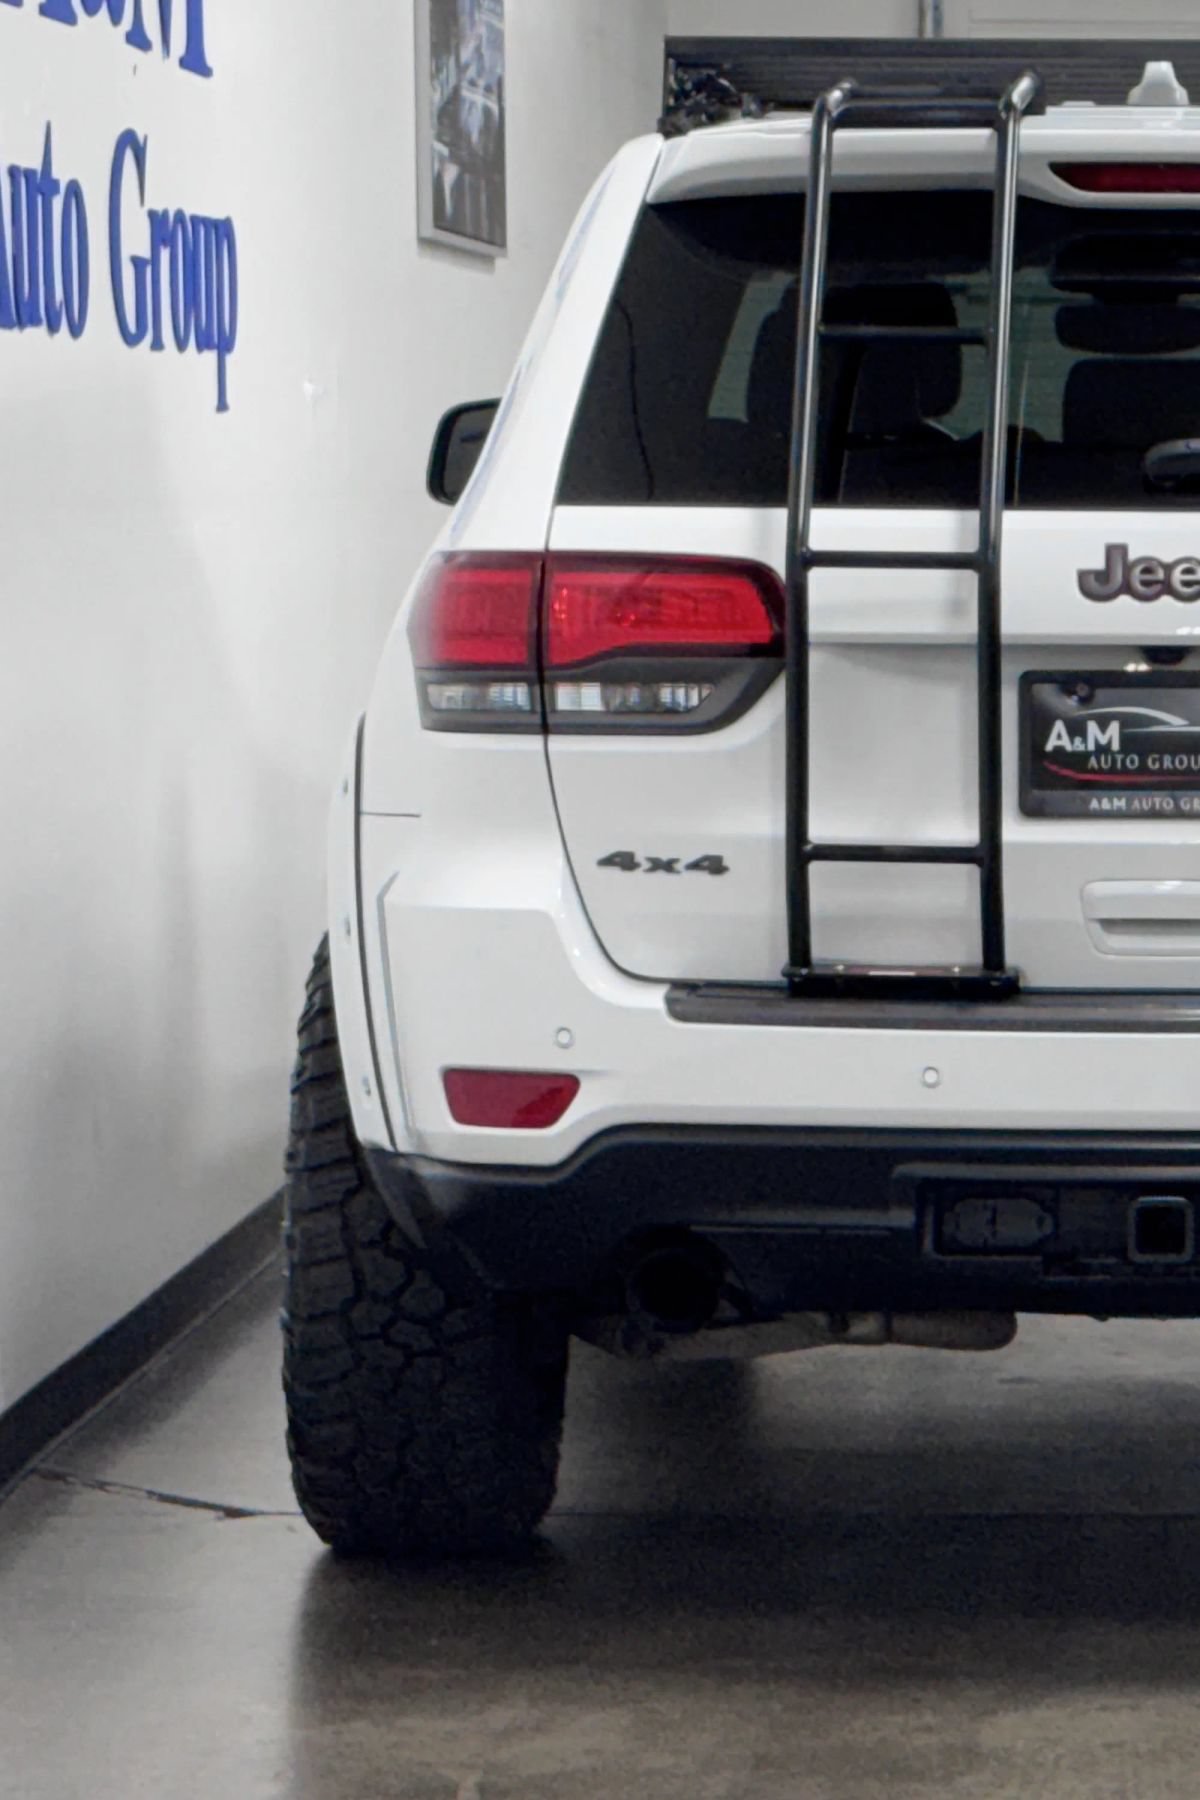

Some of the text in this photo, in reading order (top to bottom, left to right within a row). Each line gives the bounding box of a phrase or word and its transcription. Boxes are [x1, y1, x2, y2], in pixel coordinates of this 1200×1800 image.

[109, 128, 238, 412] Group
[1045, 719, 1121, 752] A&M
[1088, 754, 1139, 770] AUTO
[1089, 798, 1126, 811] A&M
[1132, 798, 1174, 811] AUTO
[597, 850, 729, 875] 4x4
